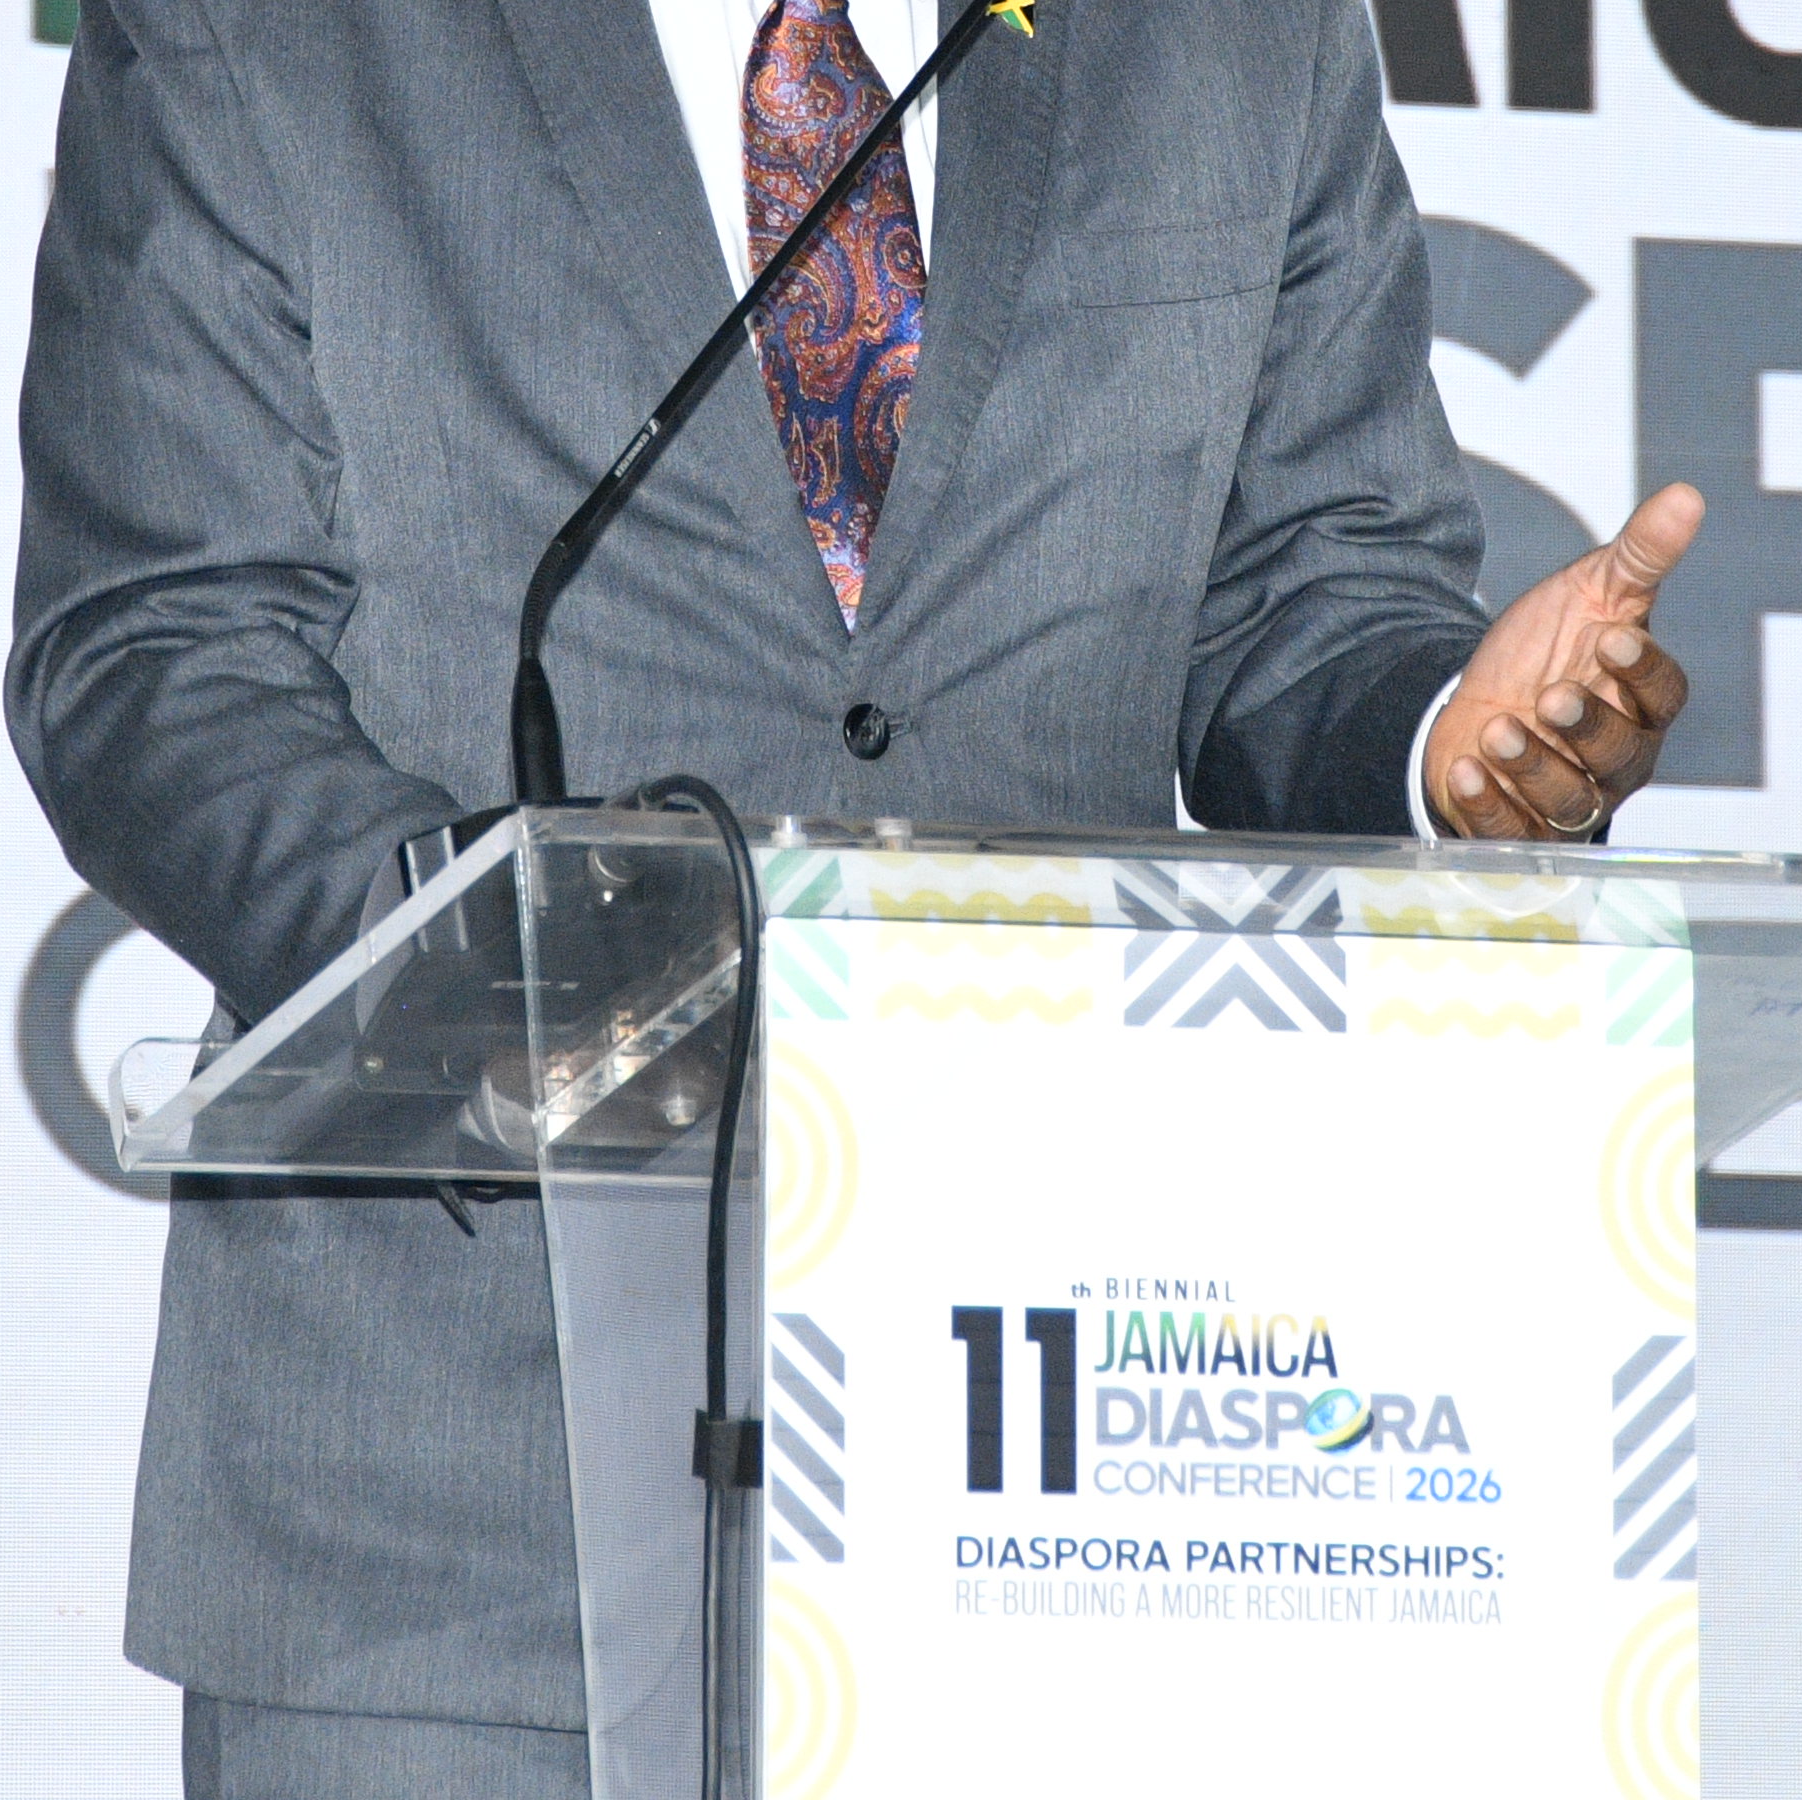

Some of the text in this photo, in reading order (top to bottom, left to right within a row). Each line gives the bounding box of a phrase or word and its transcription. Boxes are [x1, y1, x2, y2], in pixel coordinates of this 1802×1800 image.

[1071, 1277, 1236, 1302] th BIENNIAL
[1094, 1310, 1338, 1378] JAMAICA
[951, 1305, 1078, 1495] 11
[1096, 1387, 1470, 1457] DIASPORA
[1094, 1460, 1503, 1504] CONFERENCE 2026
[955, 1535, 1505, 1580] DIASPORA PARTNERSHIPS:
[956, 1579, 1502, 1624] RE-BUILDING A MORE RESILIENT JAMAICA
